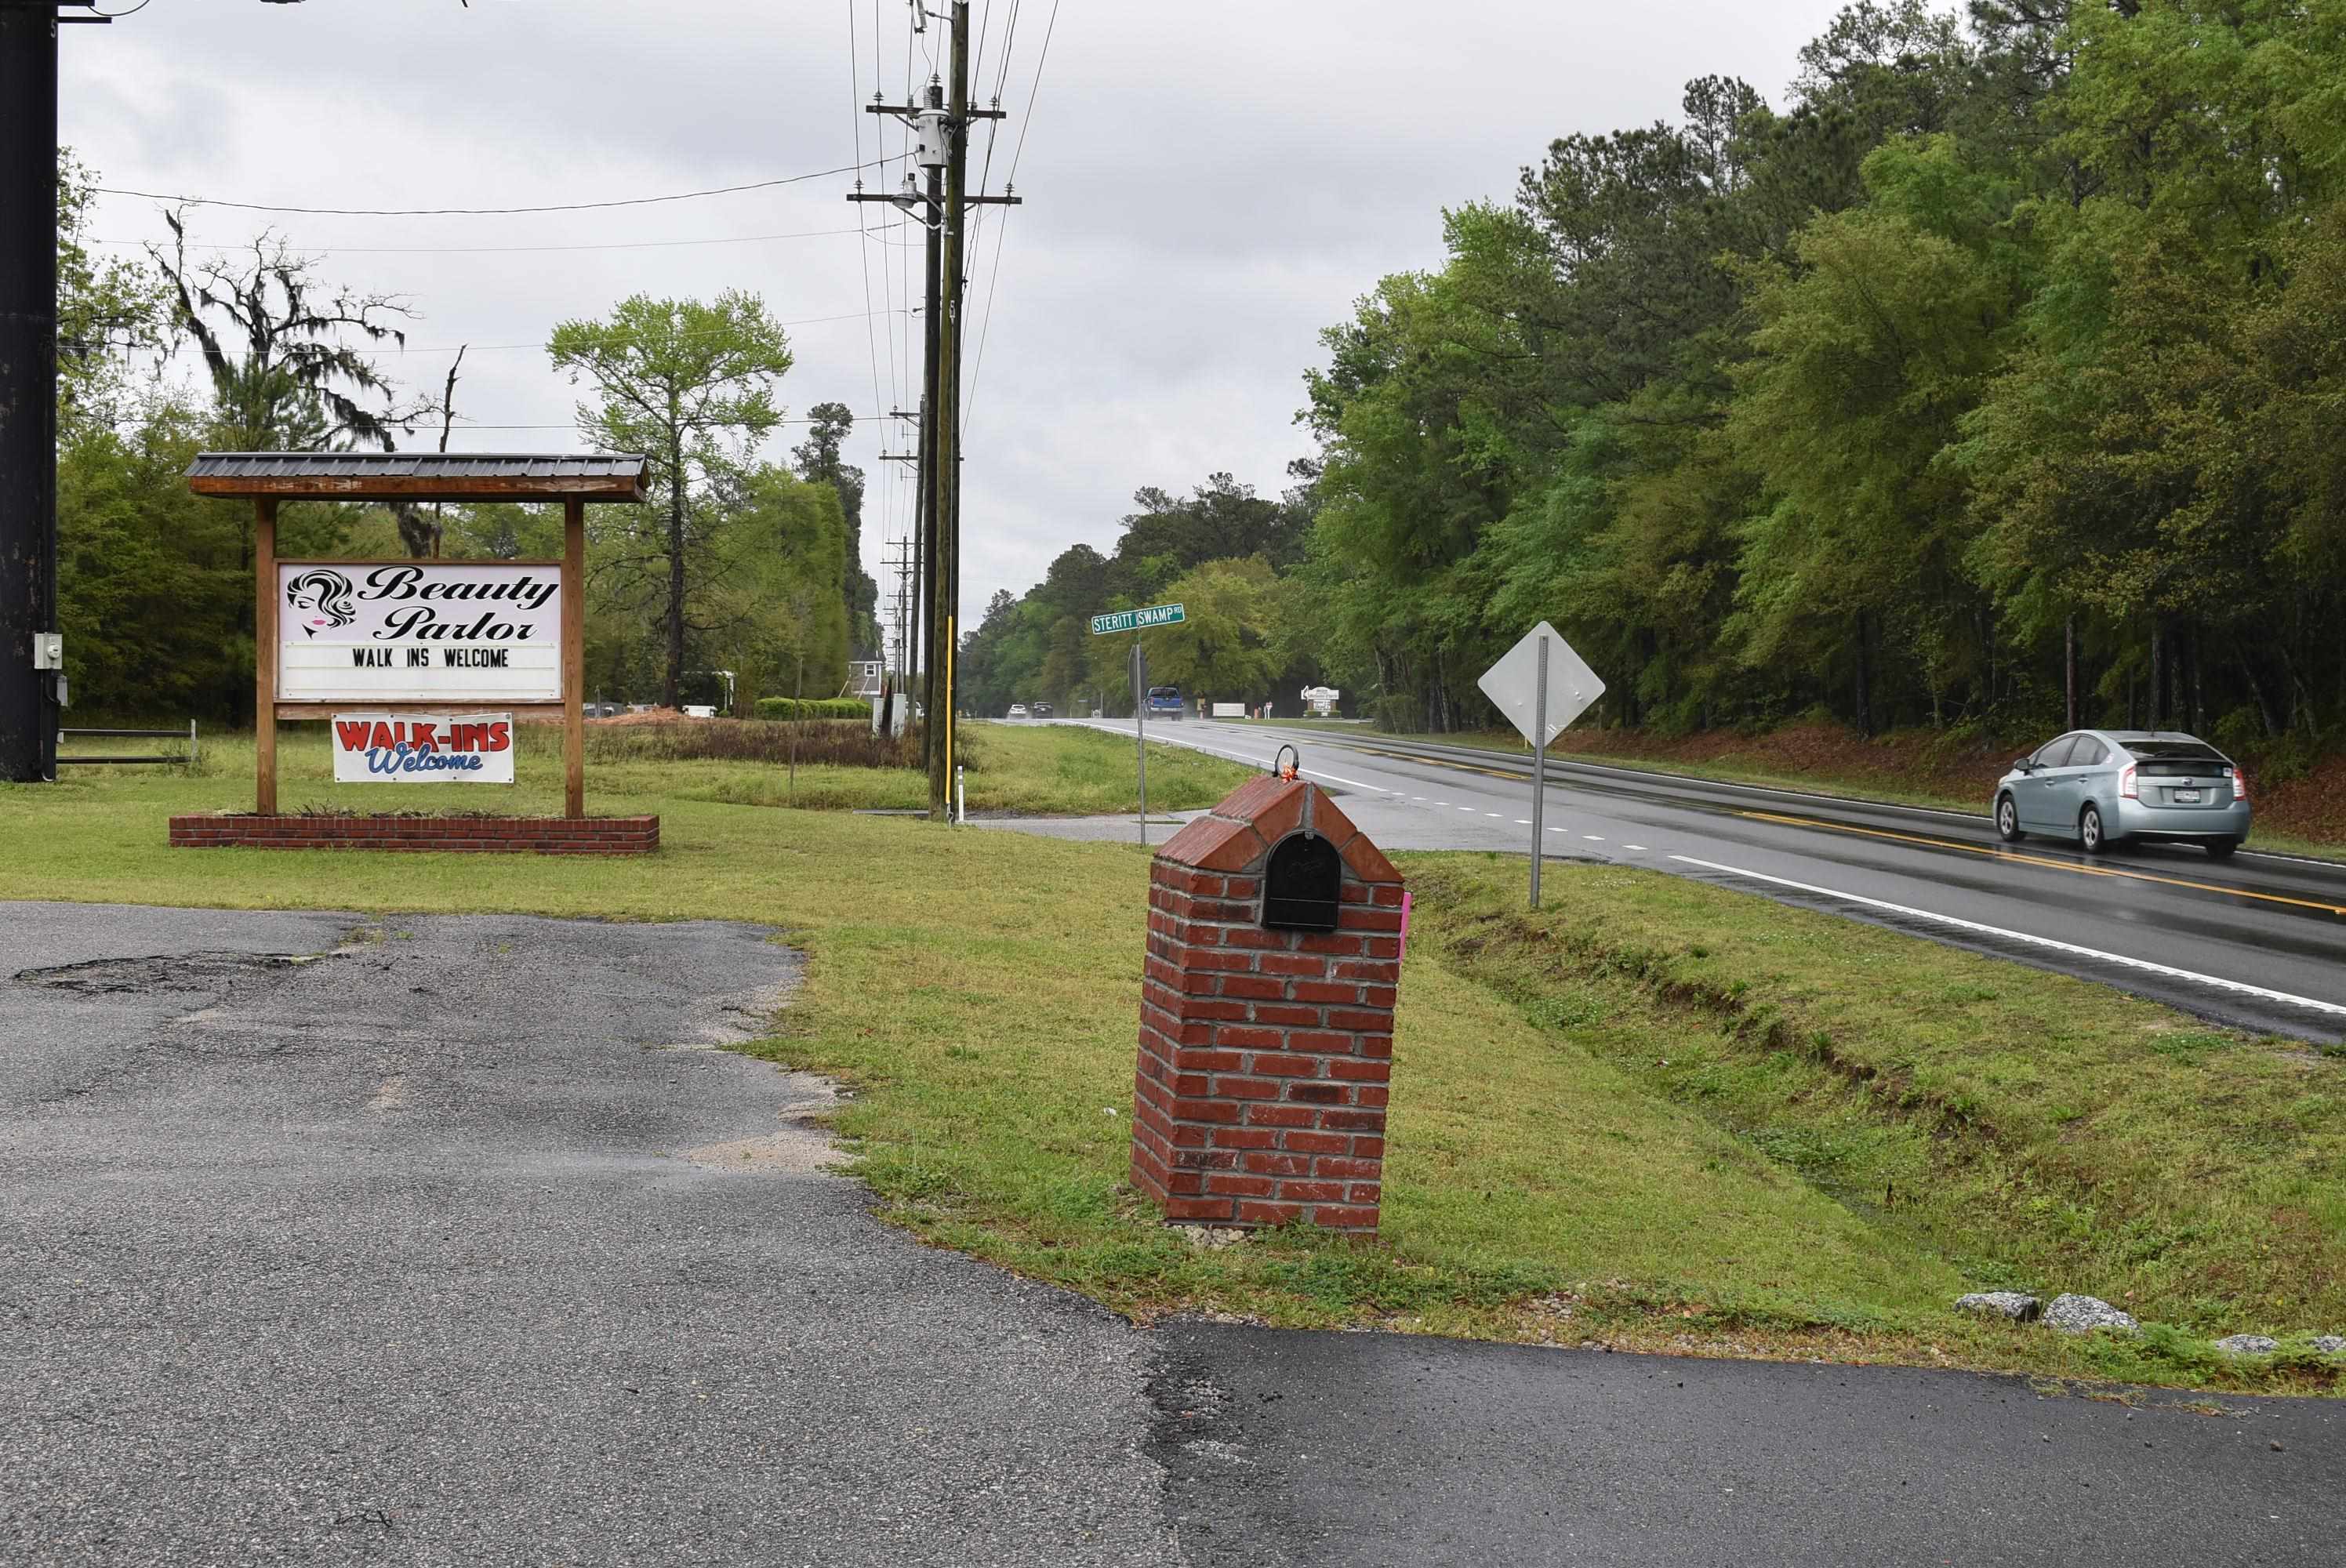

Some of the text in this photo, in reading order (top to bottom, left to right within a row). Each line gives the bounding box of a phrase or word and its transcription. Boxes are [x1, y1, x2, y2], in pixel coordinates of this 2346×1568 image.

[357, 565, 559, 610] Beauty
[372, 606, 538, 641] Parlor
[1094, 613, 1132, 632] STERITT
[1138, 607, 1173, 625] SWAMP
[352, 648, 509, 668] WALK INS WELCOME
[336, 721, 510, 753] WALK-INS
[365, 742, 483, 774] Welcome
